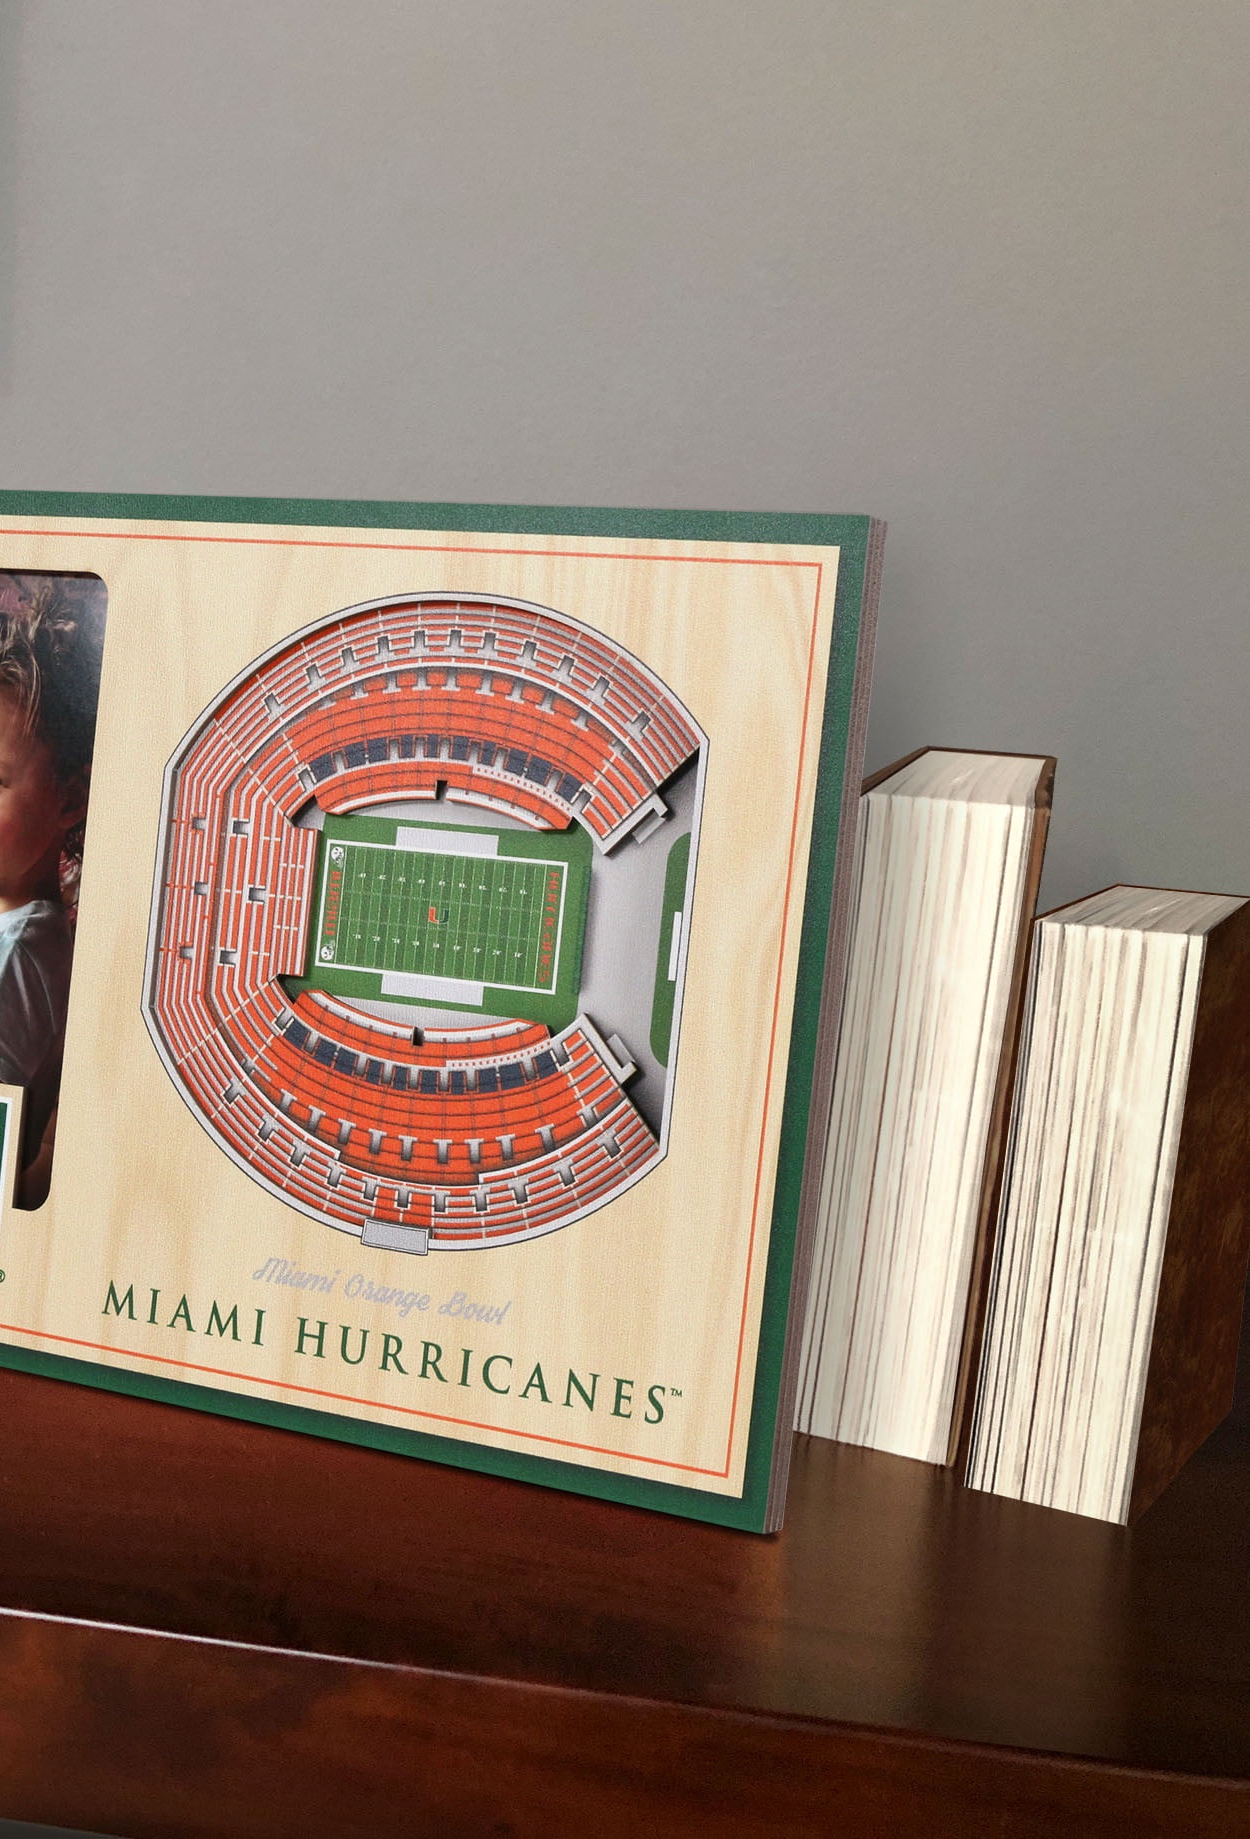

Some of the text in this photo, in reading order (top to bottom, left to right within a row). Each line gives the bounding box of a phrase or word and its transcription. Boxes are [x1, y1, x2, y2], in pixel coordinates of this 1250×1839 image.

[253, 1257, 512, 1326] Miami Orange Bowl
[101, 1279, 267, 1347] MIAMI
[294, 1316, 666, 1425] HURRICANES
